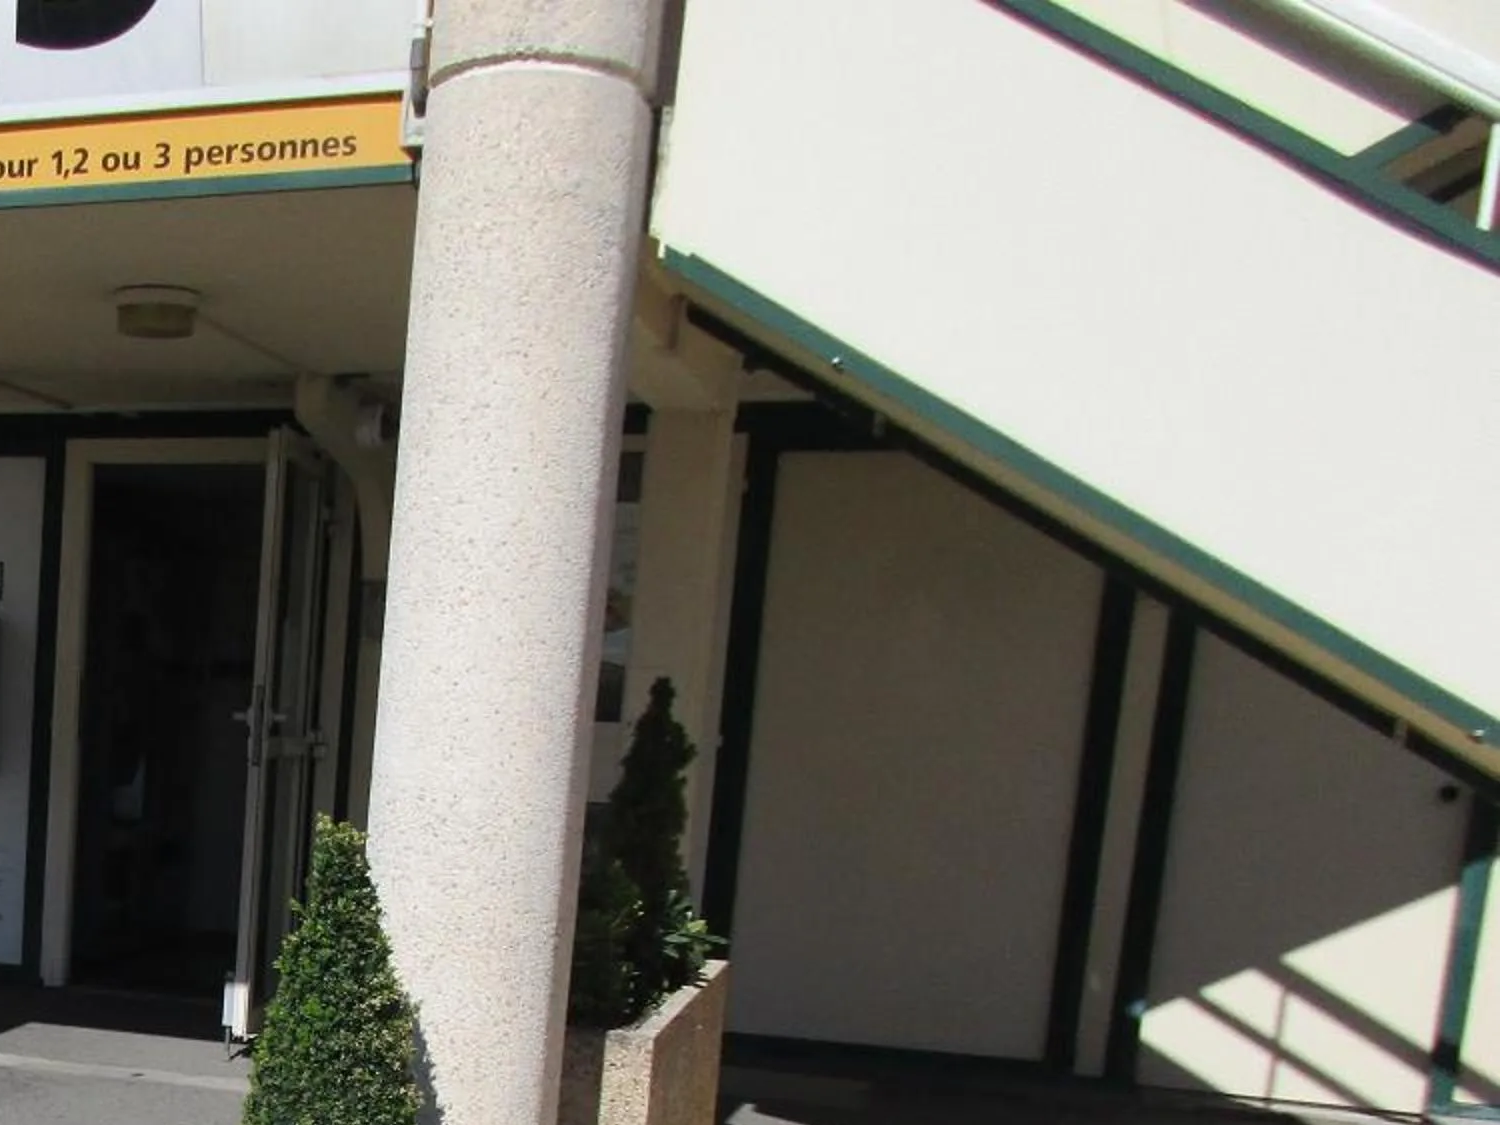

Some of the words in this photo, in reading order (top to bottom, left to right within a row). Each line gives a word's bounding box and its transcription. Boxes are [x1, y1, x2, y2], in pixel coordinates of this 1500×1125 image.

[50, 147, 89, 179] 1,2
[101, 151, 142, 173] ou
[153, 142, 172, 168] 3
[184, 134, 358, 174] personnes
